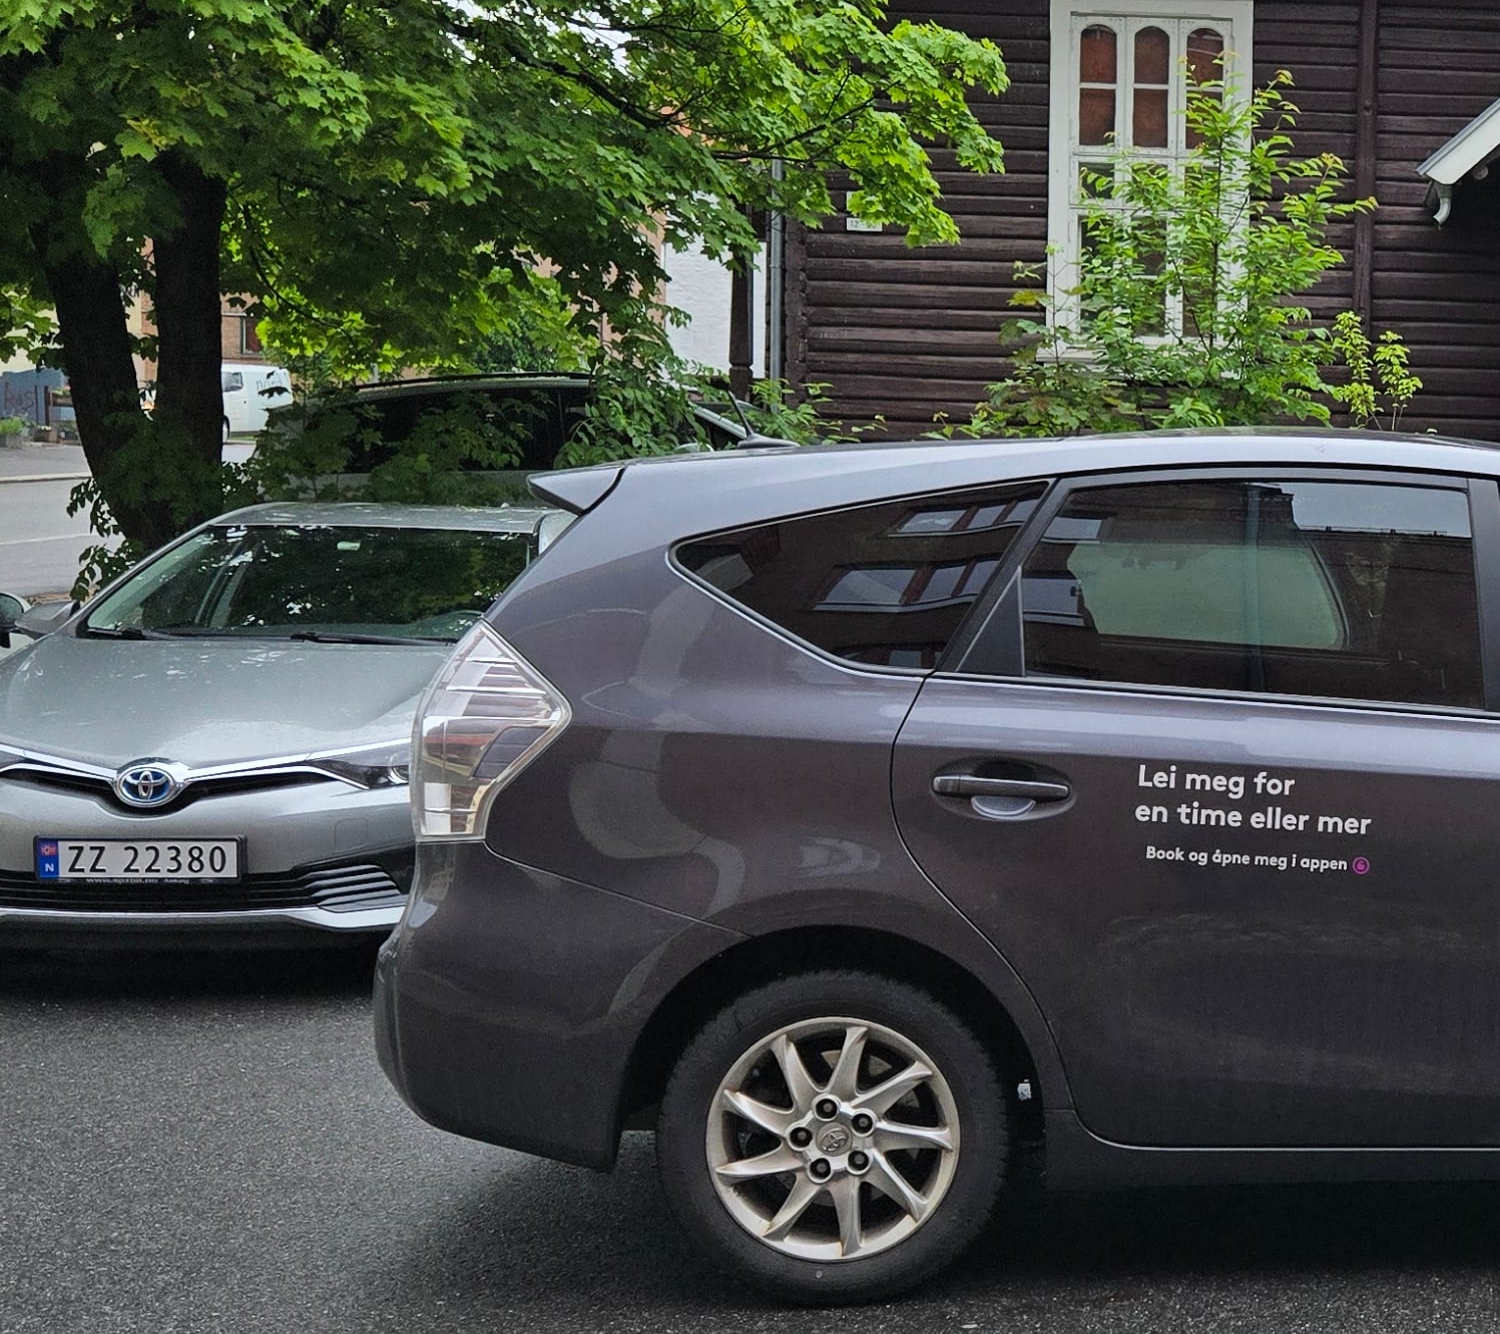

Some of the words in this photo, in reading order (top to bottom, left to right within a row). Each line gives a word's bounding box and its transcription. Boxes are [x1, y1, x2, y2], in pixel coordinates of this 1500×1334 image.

[1138, 764, 1177, 788] Lei
[1185, 771, 1245, 799] meg
[1253, 772, 1295, 795] for
[1135, 804, 1168, 823] en
[1177, 801, 1242, 827] time
[1250, 807, 1309, 831] eller
[1317, 815, 1372, 835] mer
[68, 846, 106, 873] ZZ
[123, 846, 226, 873] 22380
[1146, 846, 1184, 861] Book
[1188, 851, 1208, 865] og
[1212, 848, 1250, 866] åpne
[1254, 854, 1288, 870] meg
[1291, 854, 1297, 867] i
[1300, 856, 1348, 872] appen
